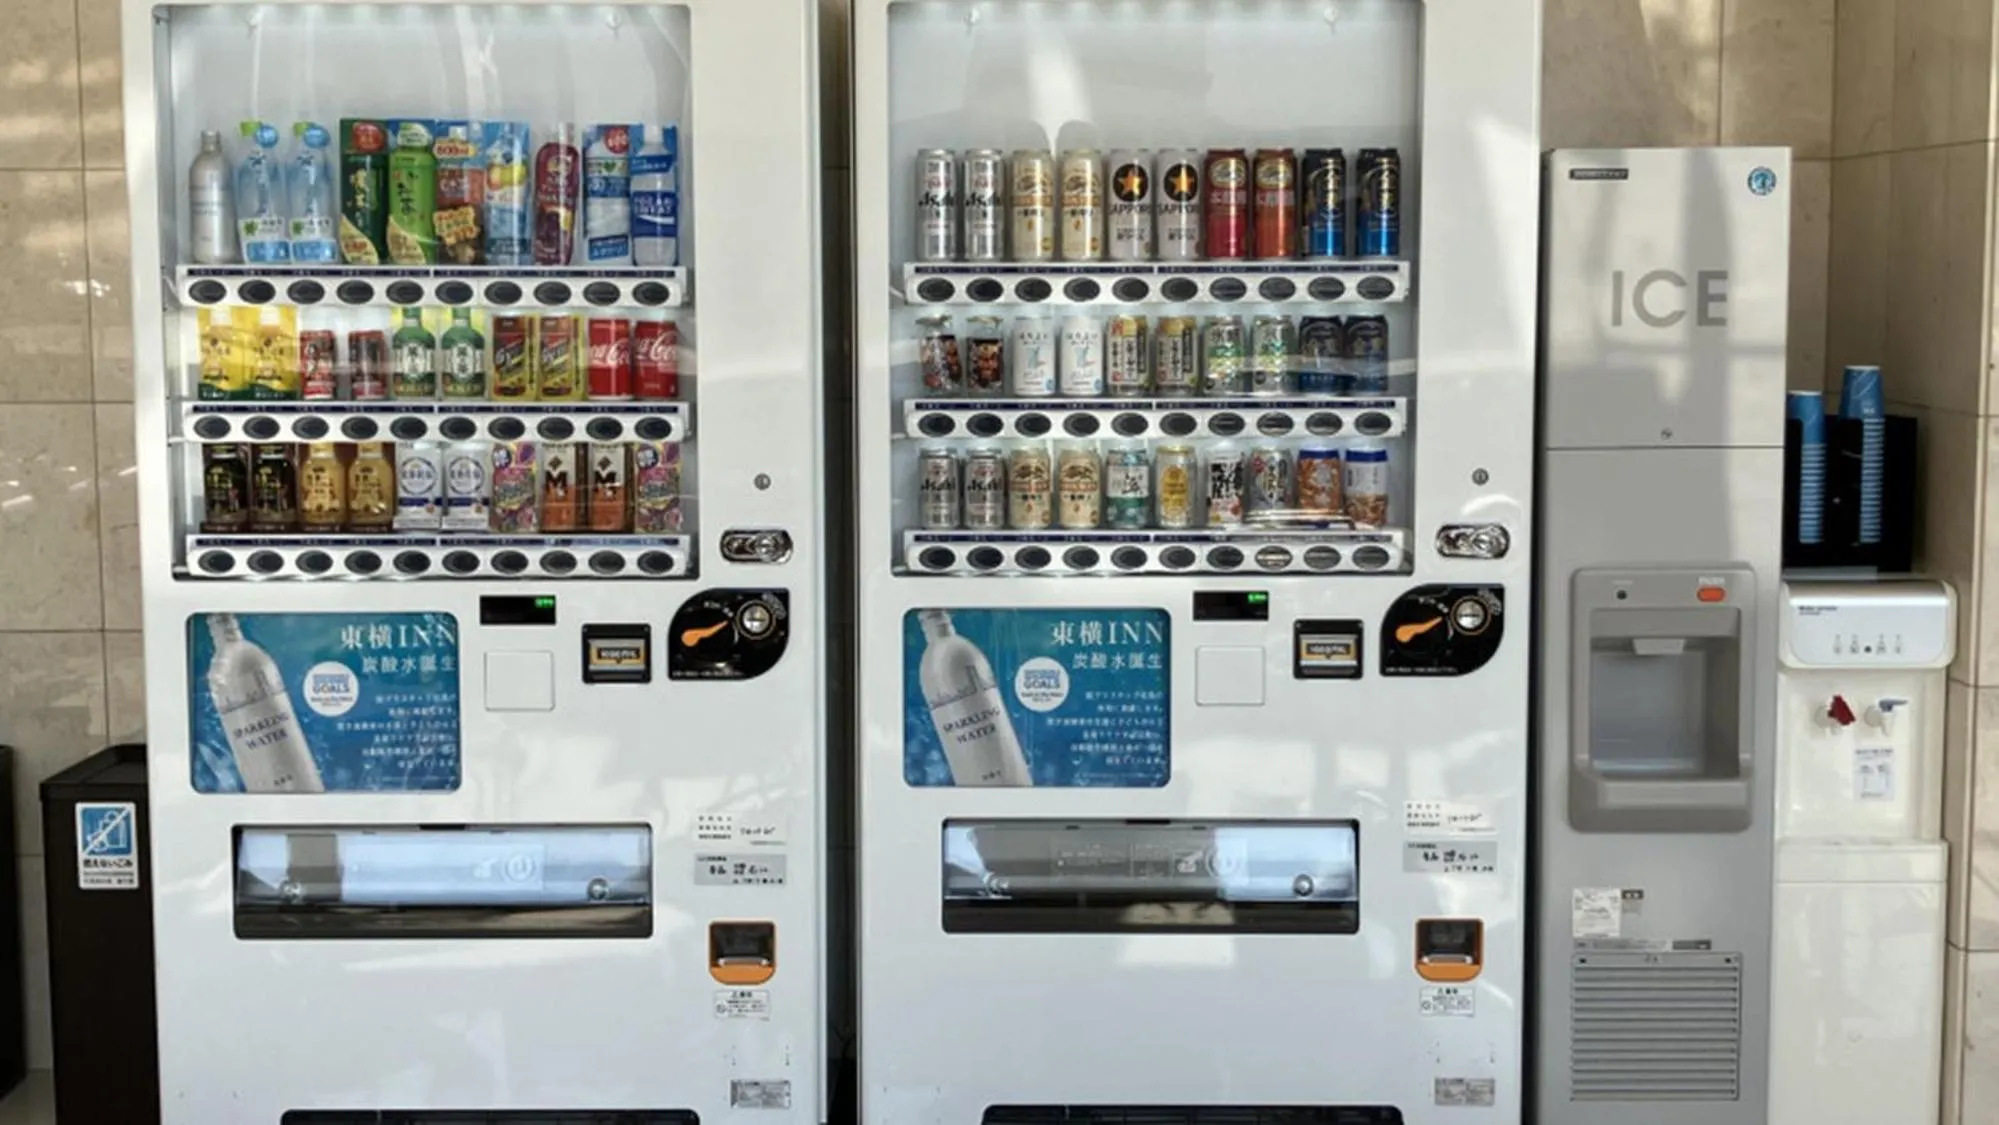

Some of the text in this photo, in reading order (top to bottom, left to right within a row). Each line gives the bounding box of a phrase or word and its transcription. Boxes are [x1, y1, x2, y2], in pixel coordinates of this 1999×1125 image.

[1611, 269, 1729, 329] ICE
[341, 622, 456, 650] 東横INN
[1051, 619, 1164, 646] 東横INN
[361, 654, 456, 675] 炭酸水誕生
[1071, 651, 1163, 671] 炭酸水誕生
[232, 711, 290, 740] SPARKLING
[942, 707, 1001, 734] SPARKLING
[956, 722, 997, 745] WATER
[246, 727, 288, 751] WATER
